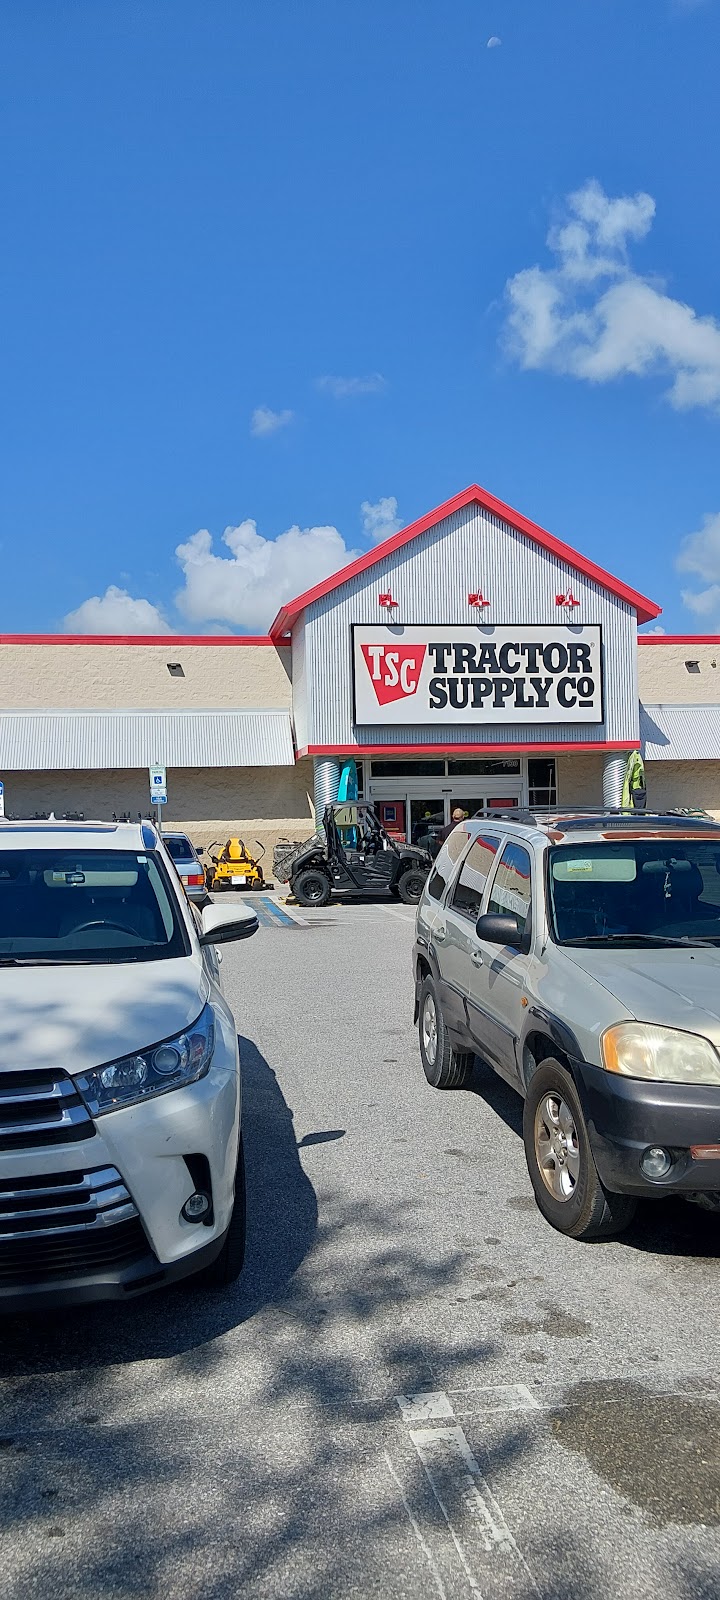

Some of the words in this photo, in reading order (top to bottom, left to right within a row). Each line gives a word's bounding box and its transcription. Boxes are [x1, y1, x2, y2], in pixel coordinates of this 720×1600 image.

[368, 646, 416, 694] TSC
[428, 642, 593, 674] TRACTOR
[428, 677, 553, 709] SUPPLY
